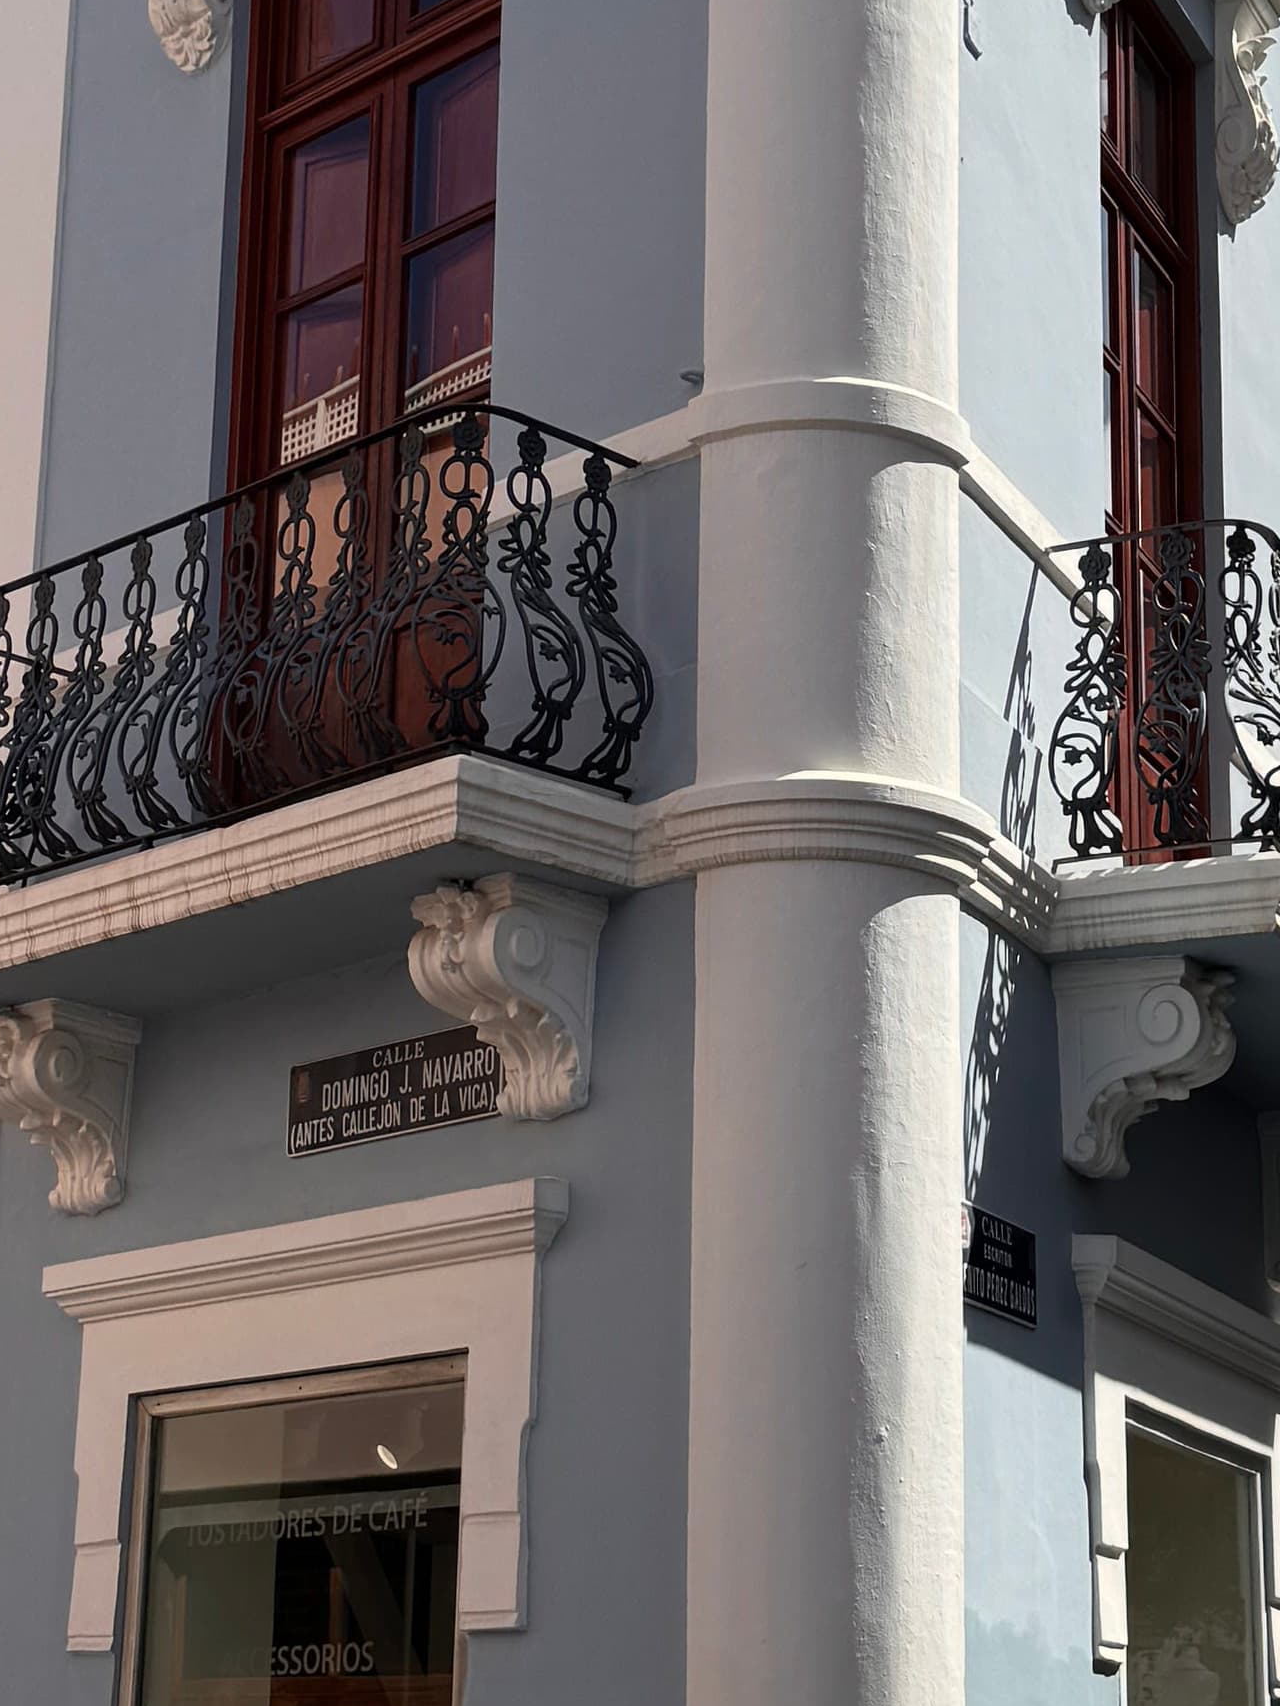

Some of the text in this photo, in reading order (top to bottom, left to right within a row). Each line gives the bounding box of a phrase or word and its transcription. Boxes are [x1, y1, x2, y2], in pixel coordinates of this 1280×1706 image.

[373, 1041, 424, 1068] CALLE
[322, 1045, 495, 1112] DOMINGO J. NAVARRO
[290, 1116, 335, 1154] (ANTES
[342, 1099, 401, 1138] CALLEJÓN
[409, 1095, 426, 1123] DE
[434, 1090, 450, 1118] LA
[981, 1215, 1013, 1246] CALLE
[986, 1266, 1008, 1307] PÉREZ
[332, 1501, 362, 1536] DE
[368, 1492, 429, 1533] CAFÉ
